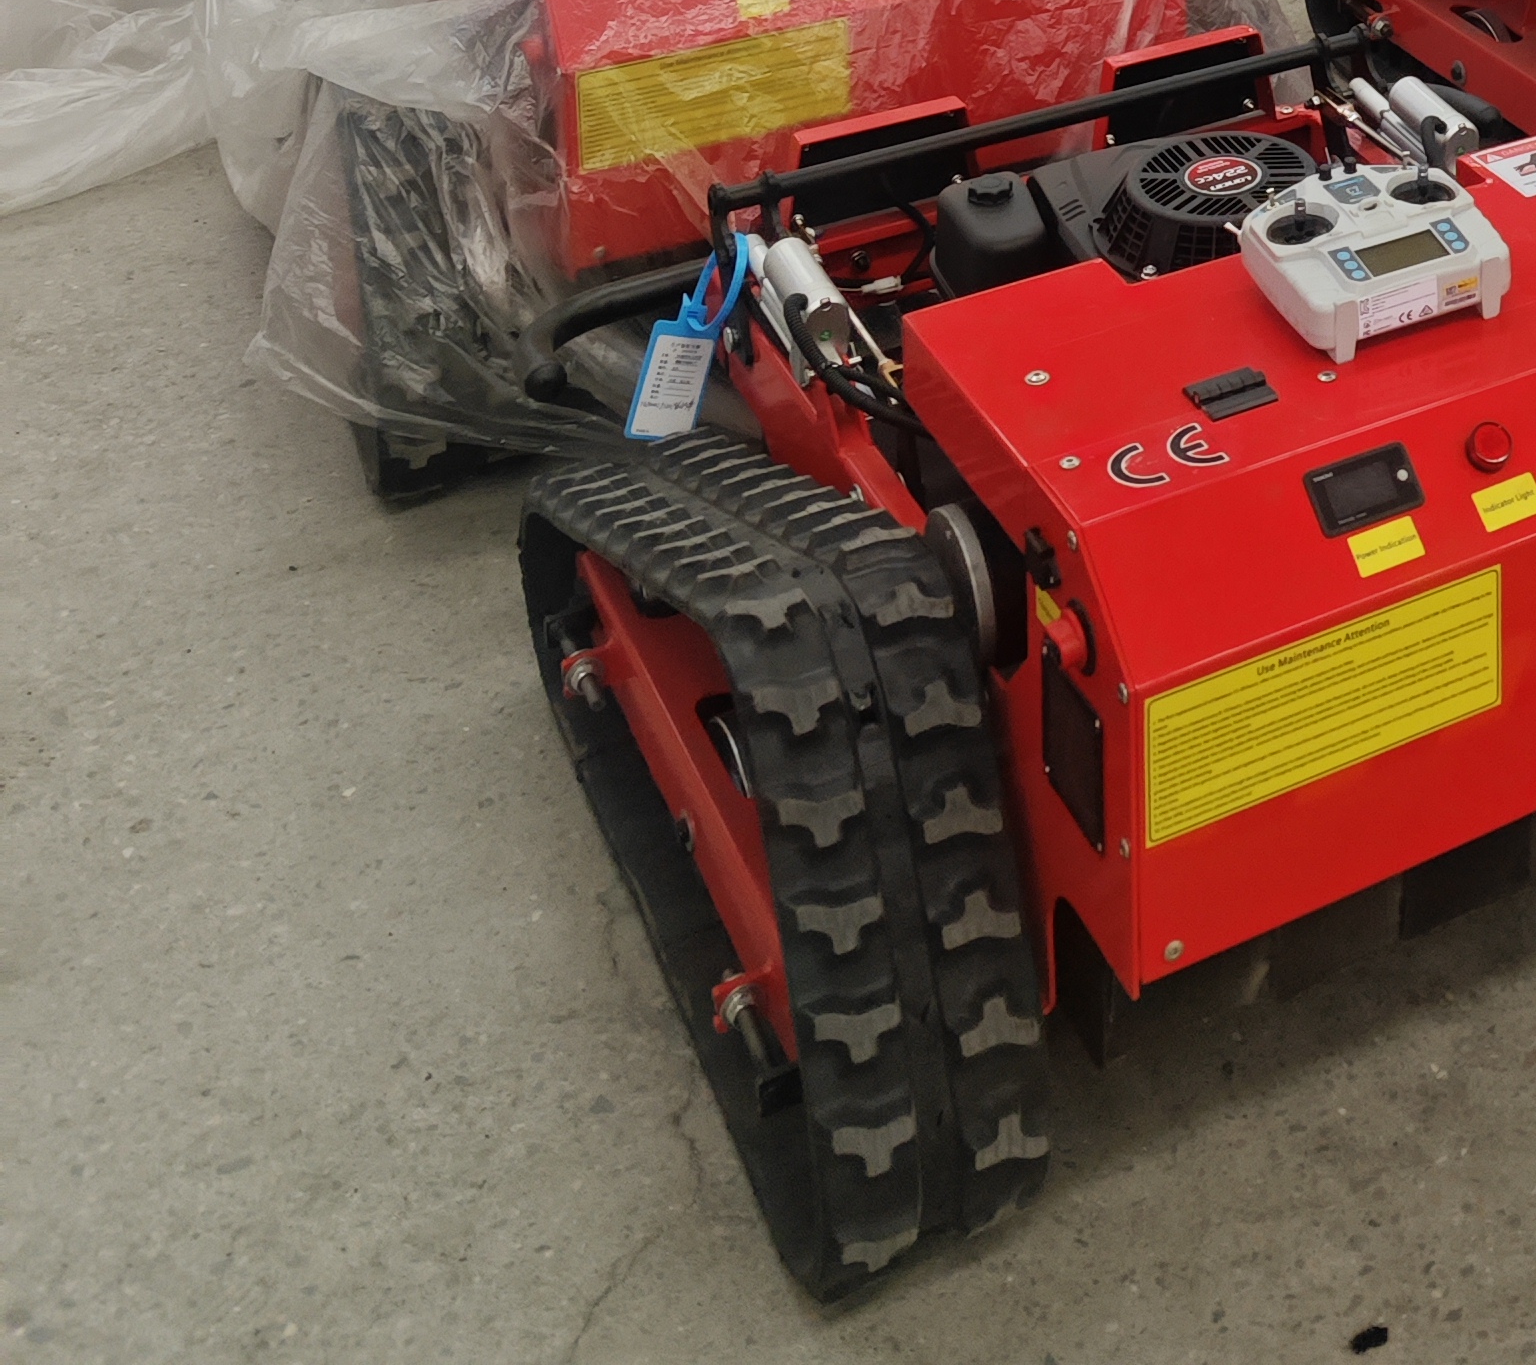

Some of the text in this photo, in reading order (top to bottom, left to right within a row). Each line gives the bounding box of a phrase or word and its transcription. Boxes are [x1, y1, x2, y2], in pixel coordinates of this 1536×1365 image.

[1398, 309, 1414, 324] CE
[1107, 422, 1230, 488] CE
[1482, 488, 1536, 514] Indicator Light
[1355, 533, 1417, 561] Power Indication
[1256, 619, 1391, 676] Use Maintenance Attention
